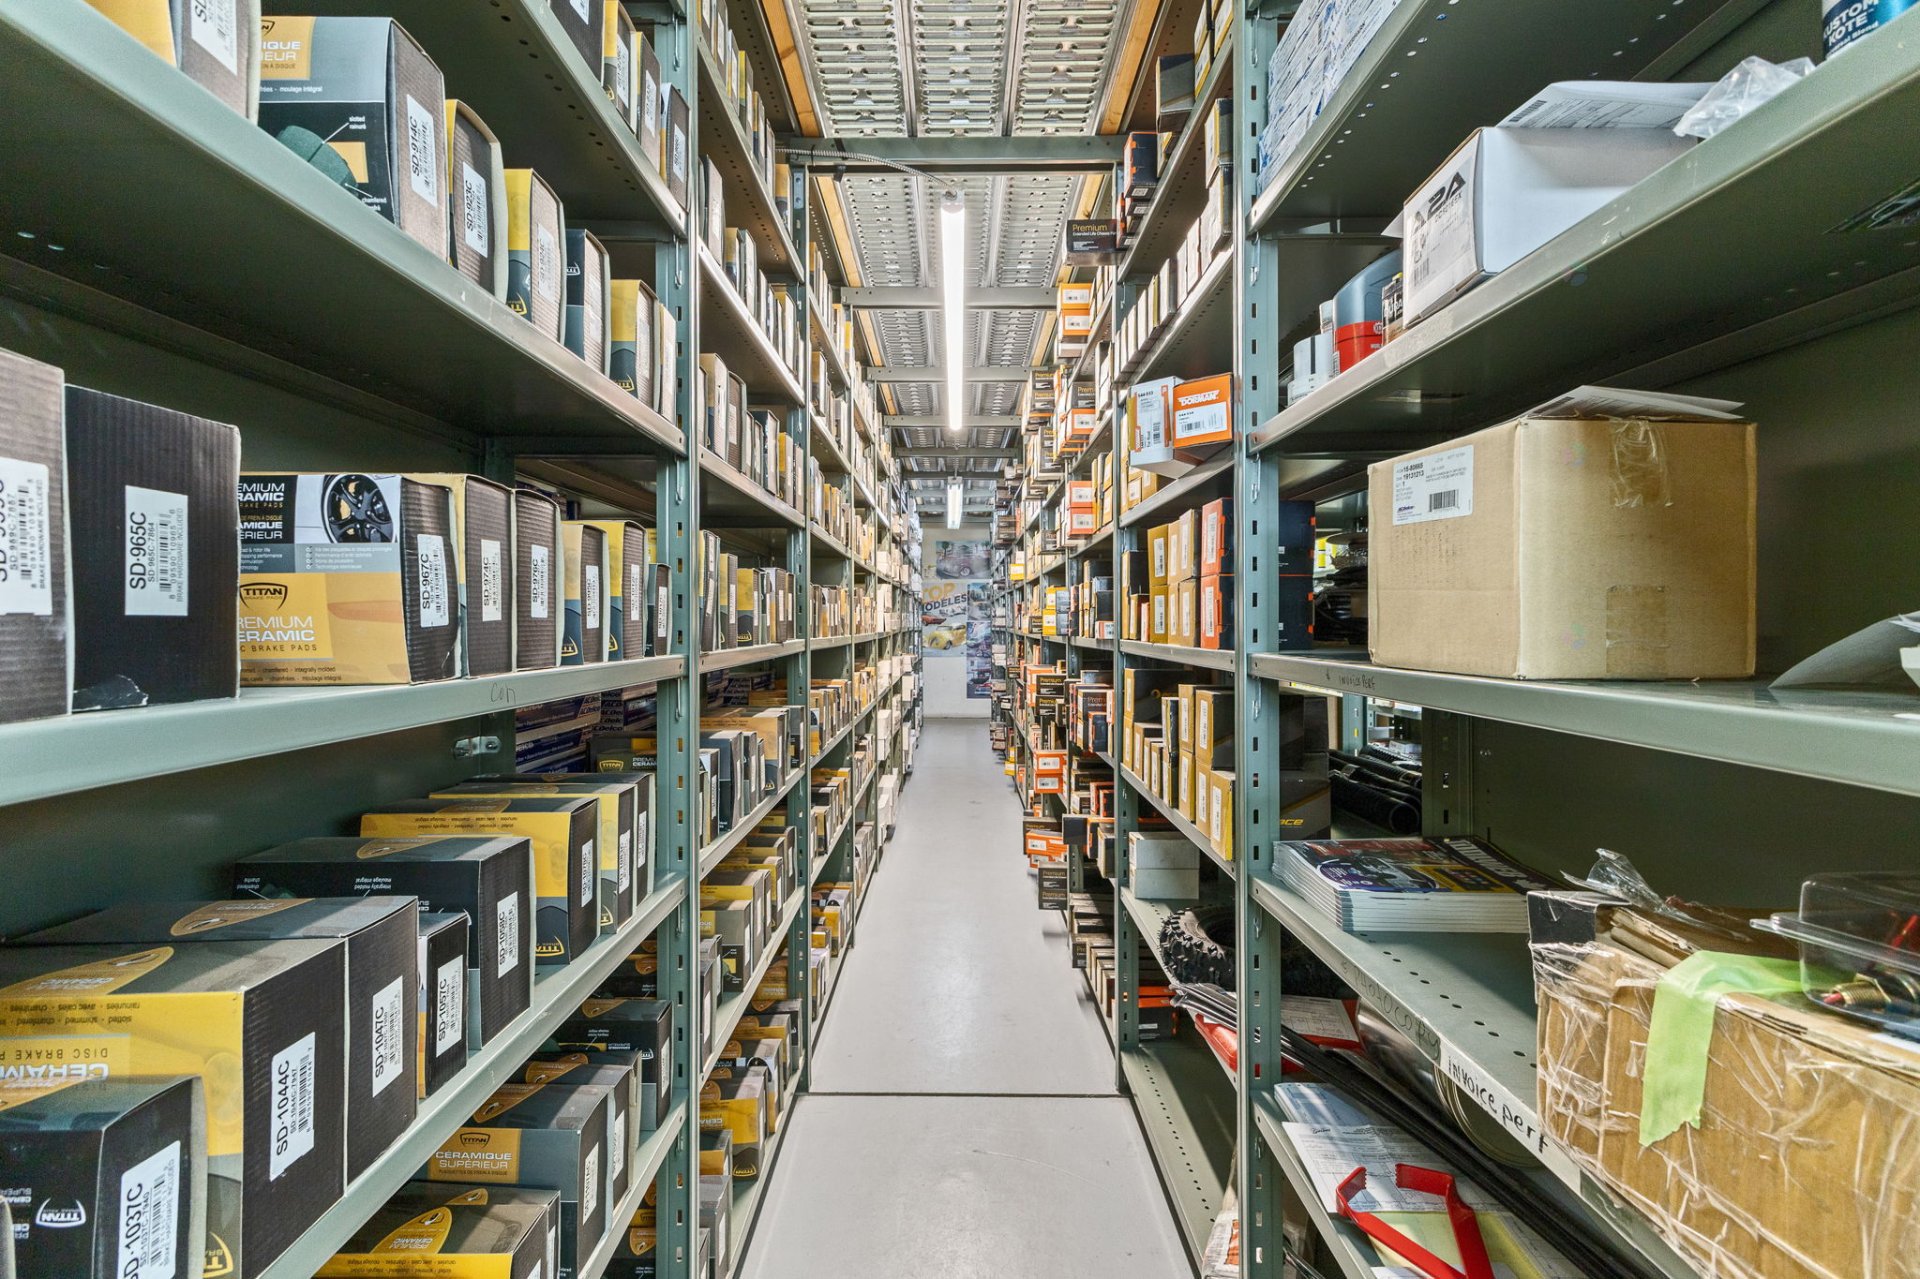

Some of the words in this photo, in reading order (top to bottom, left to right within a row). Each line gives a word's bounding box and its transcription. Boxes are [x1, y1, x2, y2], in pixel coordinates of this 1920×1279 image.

[1829, 12, 1868, 47] KOTE
[1072, 224, 1108, 232] Premium
[237, 483, 285, 492] EMIUM
[237, 492, 284, 501] RAMIC
[129, 511, 147, 590] SD-965C
[421, 553, 431, 609] SD-967C
[239, 616, 313, 629] REMIUM
[239, 630, 315, 642] ERAMIC
[251, 644, 285, 652] BRAKE
[535, 945, 560, 953] TITA
[374, 1006, 385, 1079] SD-1047C
[15, 1049, 63, 1060] BRAKE
[73, 1048, 108, 1059] DISC
[0, 1062, 109, 1081] CERAM
[276, 1059, 290, 1156] SD-1044C
[41, 1212, 80, 1222] TITAN
